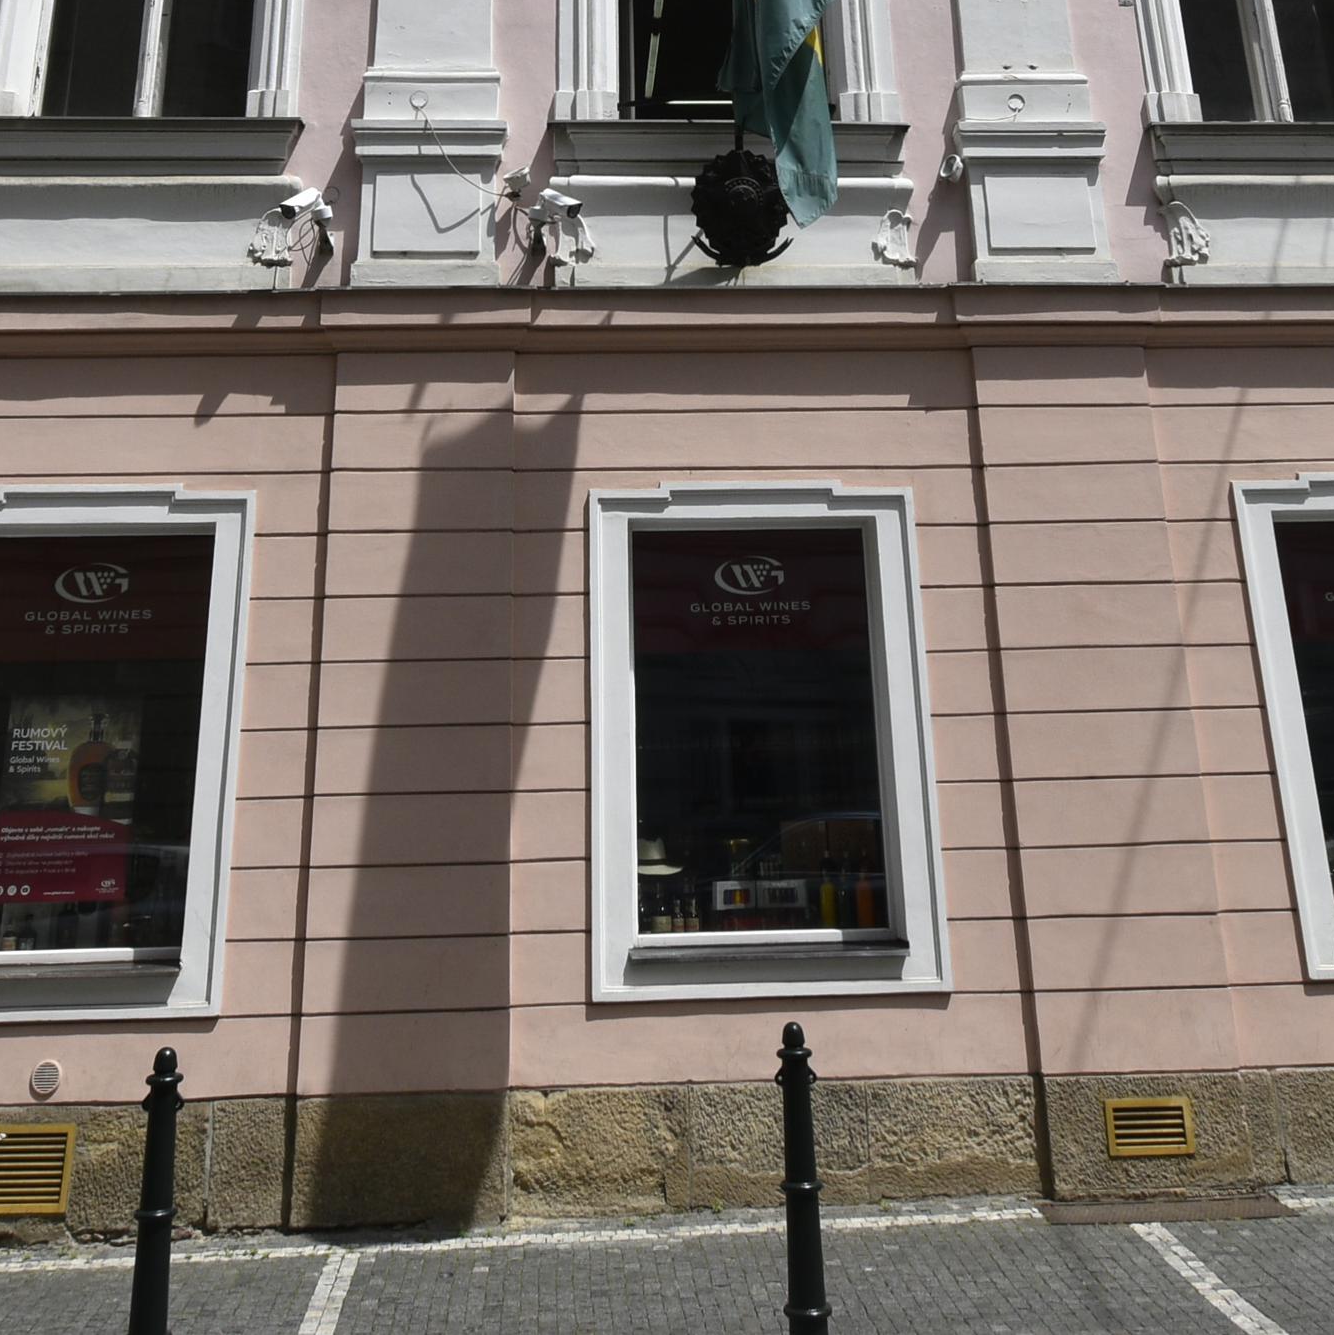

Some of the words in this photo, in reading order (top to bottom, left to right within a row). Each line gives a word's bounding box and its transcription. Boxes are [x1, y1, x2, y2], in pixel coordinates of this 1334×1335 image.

[690, 602, 754, 613] GLOBAL
[759, 600, 811, 611] WINES
[24, 610, 92, 622] GLOBAL
[97, 609, 153, 620] WINES
[712, 615, 722, 626] &
[727, 614, 791, 626] SPIRITS
[44, 624, 56, 635] &
[61, 623, 129, 635] SPIRITS
[12, 724, 68, 739] RUMOVÝ
[10, 740, 68, 751] FESTIVAL
[9, 756, 35, 764] Global
[8, 765, 15, 773] &
[16, 764, 41, 774] Spirits
